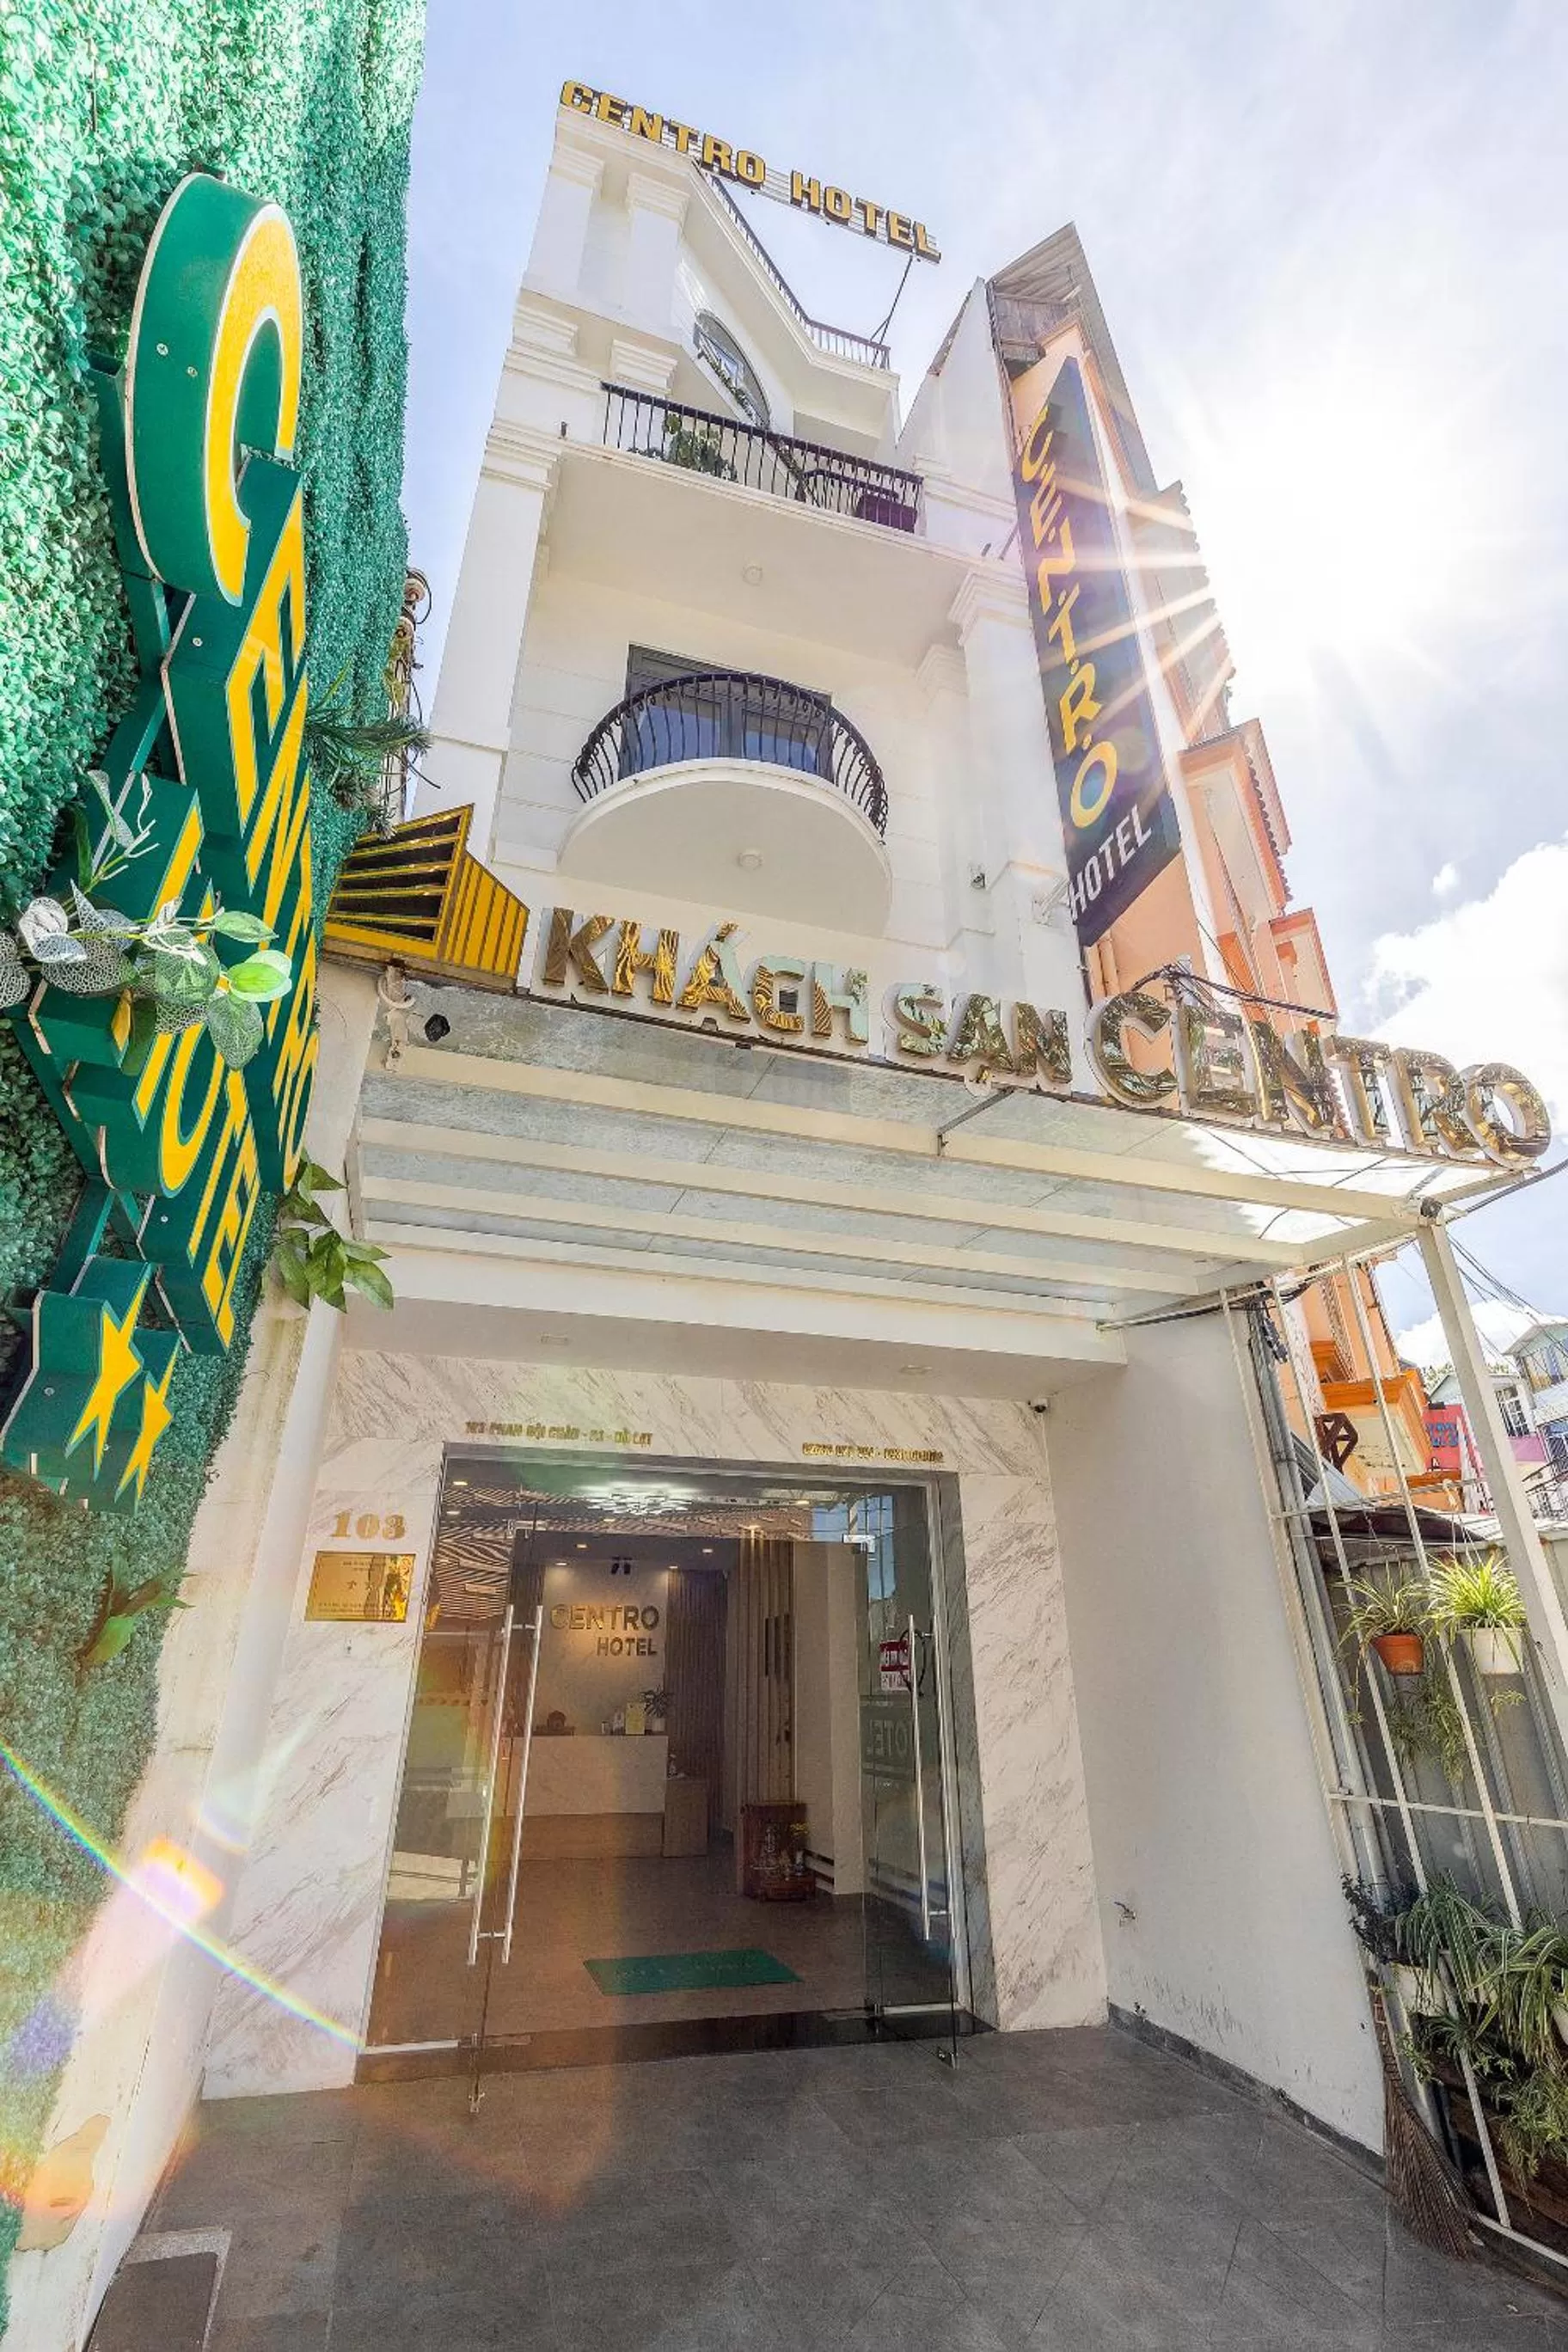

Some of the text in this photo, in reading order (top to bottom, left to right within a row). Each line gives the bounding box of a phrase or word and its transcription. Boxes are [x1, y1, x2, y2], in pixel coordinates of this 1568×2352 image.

[560, 80, 942, 264] CENTRO HOTEL
[1021, 406, 1118, 829] CENTRO
[1069, 804, 1153, 922] HOTEL
[540, 907, 868, 1046] KHÁCH
[1084, 990, 1553, 1169] CENTRO
[330, 1508, 406, 1540] 103
[549, 1603, 660, 1632] CENTRO
[596, 1637, 658, 1657] HOTEL
